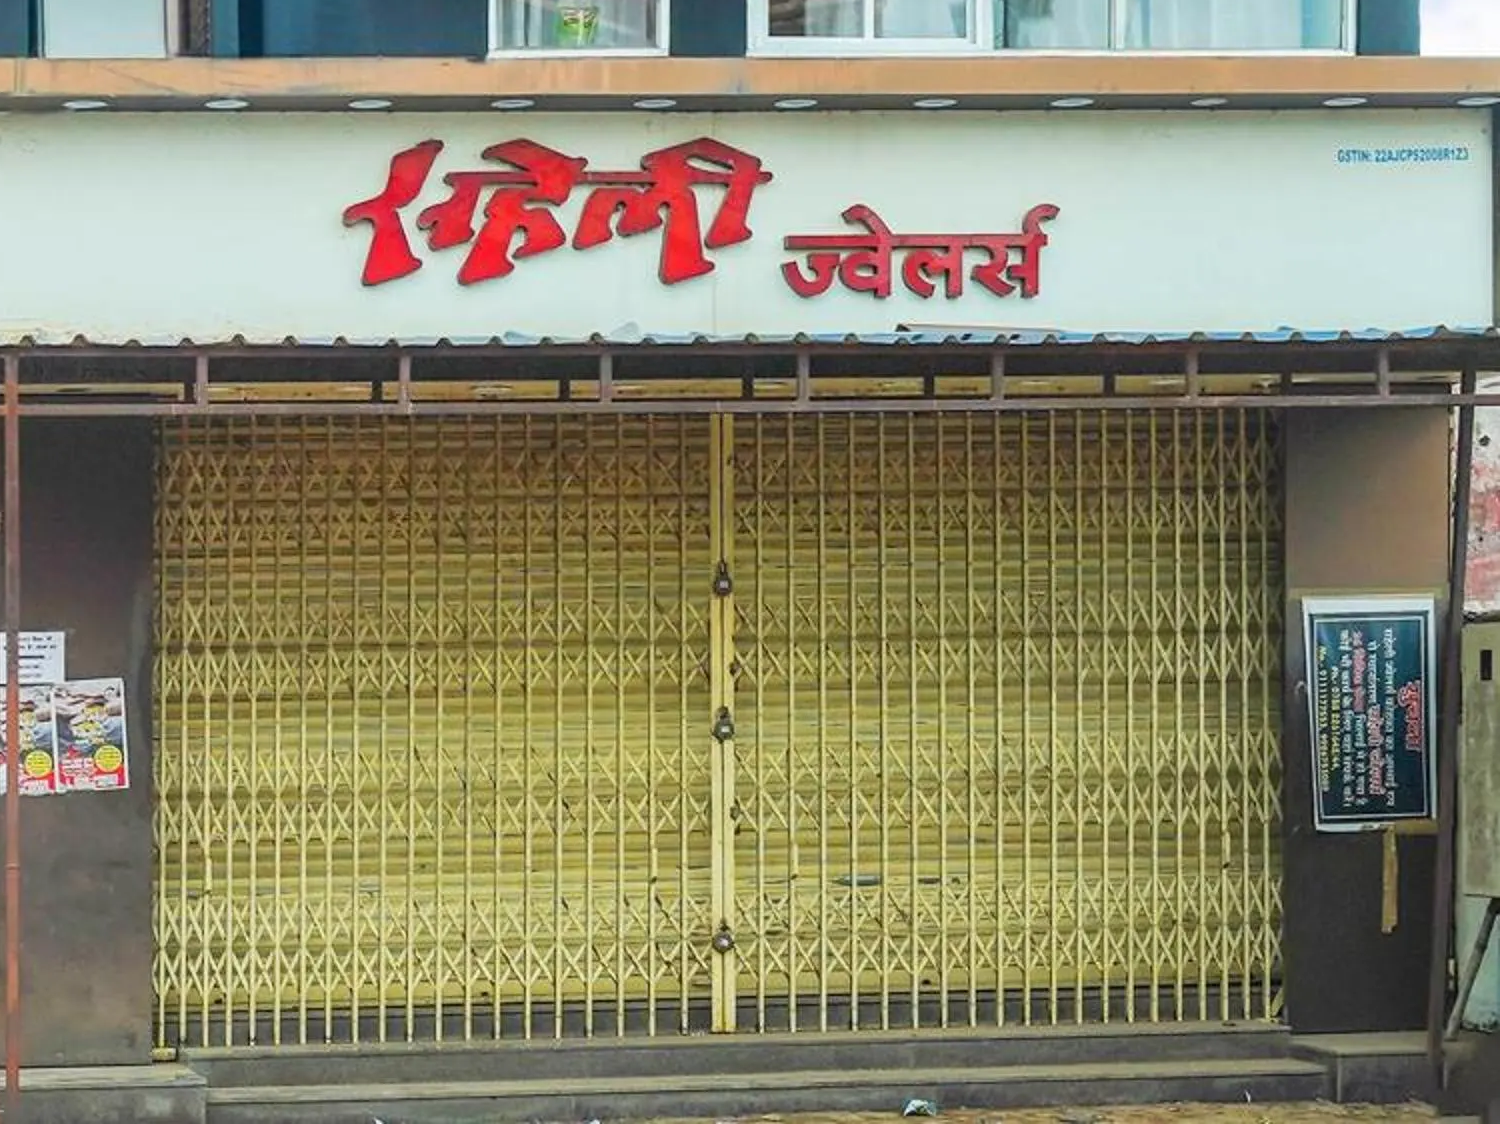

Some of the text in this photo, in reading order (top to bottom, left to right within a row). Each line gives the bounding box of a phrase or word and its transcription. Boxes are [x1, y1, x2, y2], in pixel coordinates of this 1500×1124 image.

[1337, 149, 1371, 163] GSTIN:
[343, 138, 1061, 299] सहेली ज्वेलर्स
